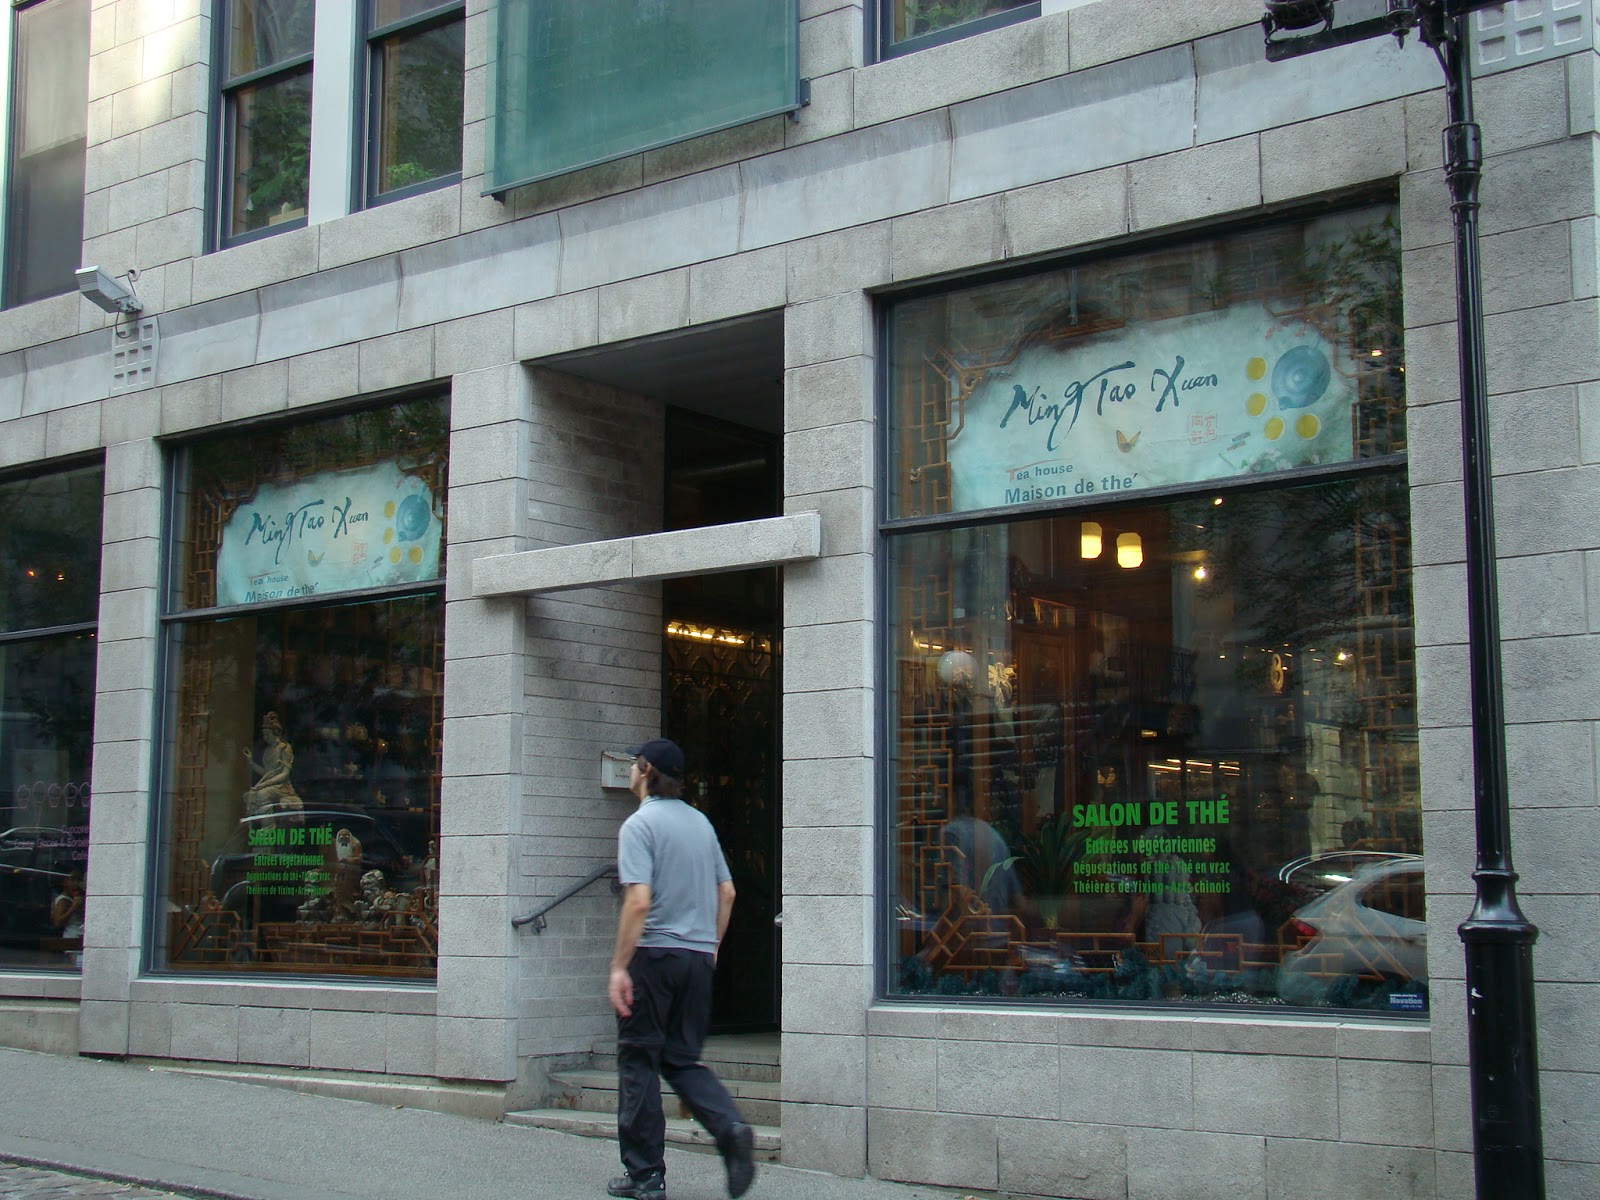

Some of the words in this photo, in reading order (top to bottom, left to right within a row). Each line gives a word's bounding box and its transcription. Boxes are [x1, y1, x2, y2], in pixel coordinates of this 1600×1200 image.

[1000, 381, 1084, 451] Ming
[1082, 361, 1136, 416] Tao
[1151, 356, 1218, 412] Xuan
[1006, 465, 1031, 482] Tea
[1035, 464, 1074, 477] house
[1005, 484, 1067, 504] Maison
[1074, 479, 1095, 494] de
[245, 512, 294, 565] Ming
[292, 499, 325, 539] Tao
[332, 497, 369, 538] Xuan
[249, 576, 264, 587] Tea
[266, 574, 289, 584] house
[245, 588, 283, 602] Maison
[287, 586, 300, 597] de
[1072, 802, 1141, 828] SALON
[1149, 801, 1178, 826] DE
[1185, 794, 1230, 825] THÉ
[247, 828, 286, 846] SALON
[289, 828, 306, 846] DE
[308, 822, 333, 845] THÉ
[1085, 834, 1129, 855] Entrées
[1132, 835, 1217, 857] végétariennes
[1073, 860, 1138, 877] Dégustations
[1140, 860, 1152, 874] de
[1153, 859, 1170, 874] thé
[1175, 859, 1193, 874] Thé
[1195, 862, 1207, 873] en
[1209, 861, 1231, 874] vrac
[1073, 879, 1115, 894] Théières
[1118, 880, 1131, 893] de
[1133, 880, 1164, 896] Yixing
[1171, 881, 1193, 894] Arts
[1194, 880, 1231, 894] chinois
